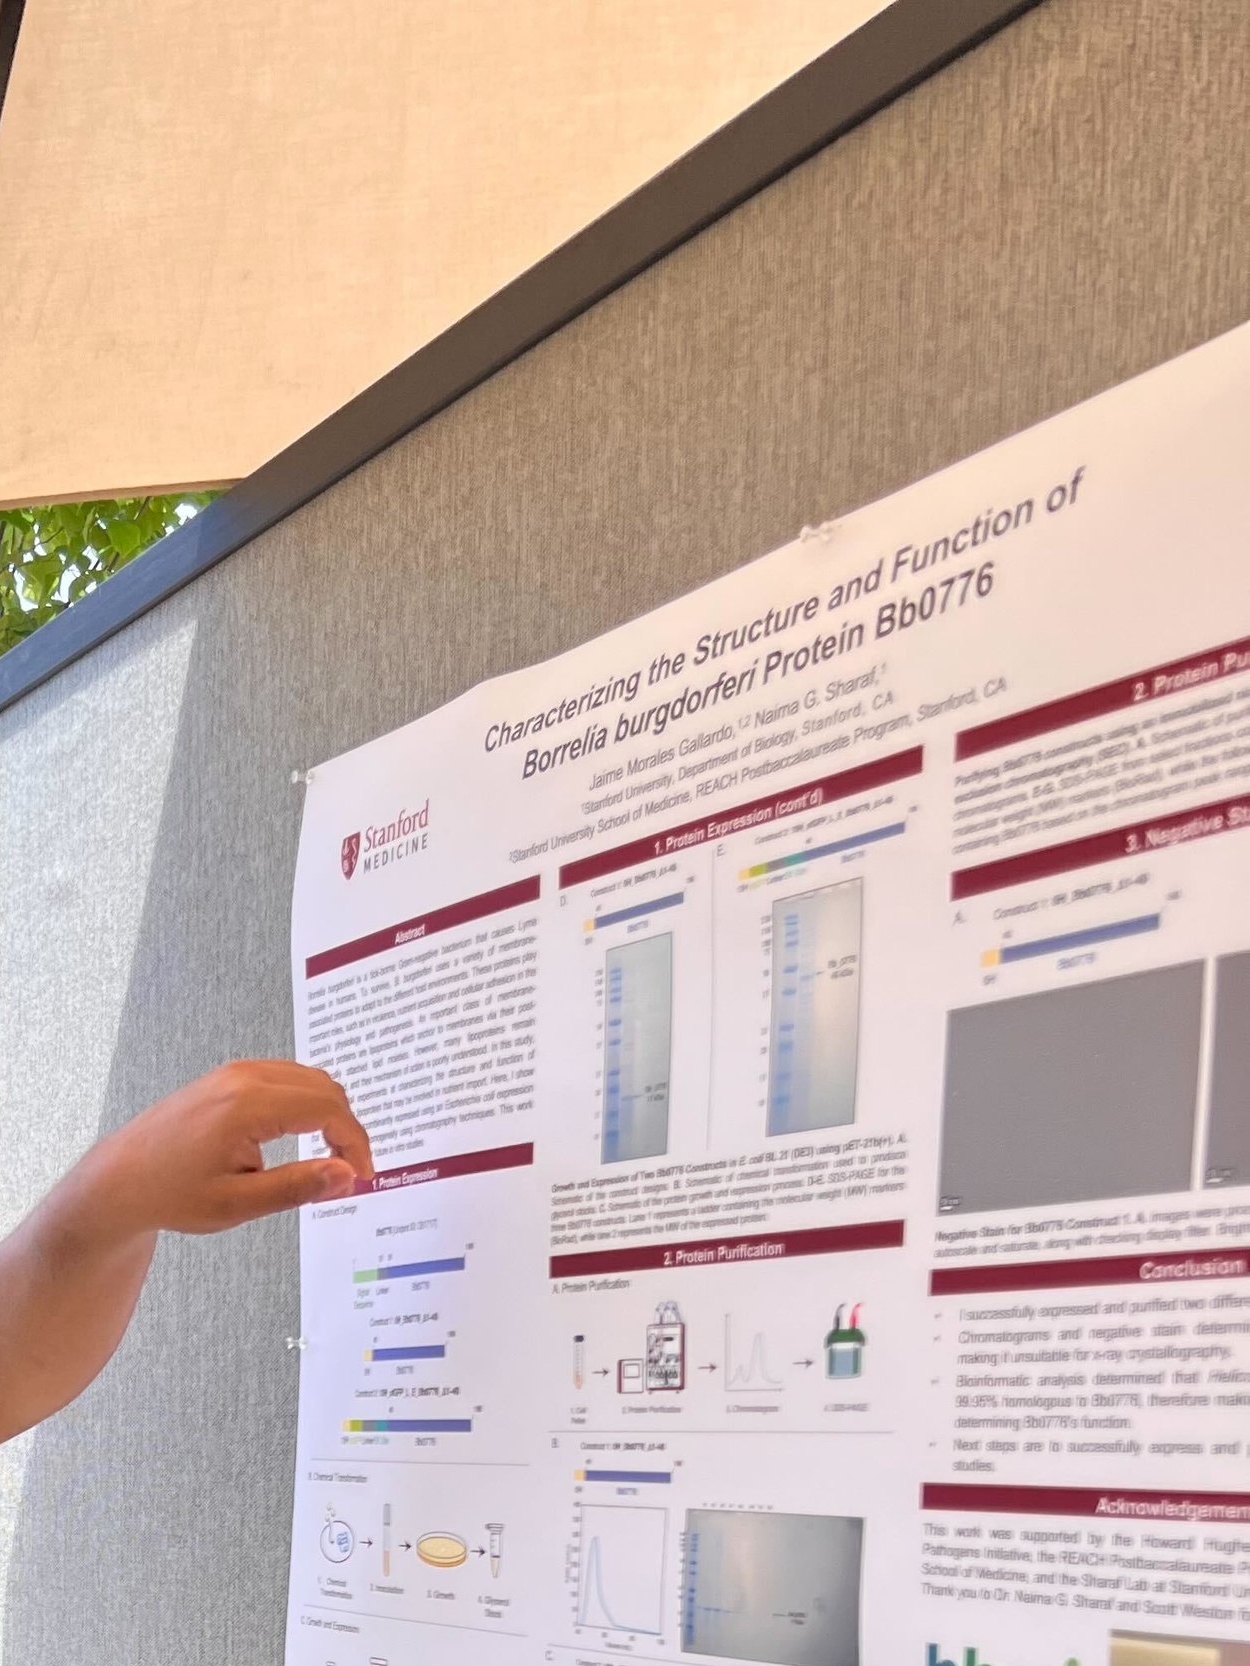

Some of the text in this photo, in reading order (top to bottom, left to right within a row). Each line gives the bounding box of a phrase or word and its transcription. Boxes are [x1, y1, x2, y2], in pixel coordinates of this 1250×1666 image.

[484, 466, 1086, 752] Characterizing the Structure and Function of
[521, 561, 994, 779] Borrelia burgdorferi Protein Bb0776
[1153, 662, 1219, 694] Protein
[589, 767, 623, 791] Jaime
[627, 747, 674, 776] Morales
[754, 700, 798, 727] Naima
[802, 689, 820, 709] G.
[677, 747, 738, 781] Department
[741, 741, 751, 758] of
[754, 729, 798, 753] Biology,
[871, 690, 894, 710] CA
[550, 825, 595, 849] University
[597, 811, 630, 833] School
[632, 804, 642, 821] of
[696, 771, 737, 799] REACH
[741, 735, 850, 782] Postbaccalaureate
[983, 676, 1007, 698] CA
[364, 798, 429, 853] Stanford
[654, 841, 663, 855] 1.
[665, 829, 704, 850] Protein
[707, 807, 771, 844] Expression
[774, 788, 822, 819] (cont'd)
[1144, 815, 1223, 848] Negative
[363, 833, 428, 874] MEDICINE
[394, 924, 425, 943] Abstract
[379, 1176, 400, 1188] Protein
[401, 1169, 437, 1184] Expression
[663, 1243, 785, 1265] 2. Protein Purification
[1140, 1259, 1242, 1279] Conclusion
[561, 1283, 586, 1292] Protein
[1102, 1301, 1125, 1314] and
[1057, 1328, 1081, 1341] and
[957, 1353, 998, 1366] making
[1073, 1348, 1089, 1361] for
[952, 1439, 979, 1451] Next
[984, 1441, 1017, 1452] steps
[1022, 1442, 1043, 1452] are
[953, 1527, 982, 1538] work
[988, 1530, 1013, 1540] was
